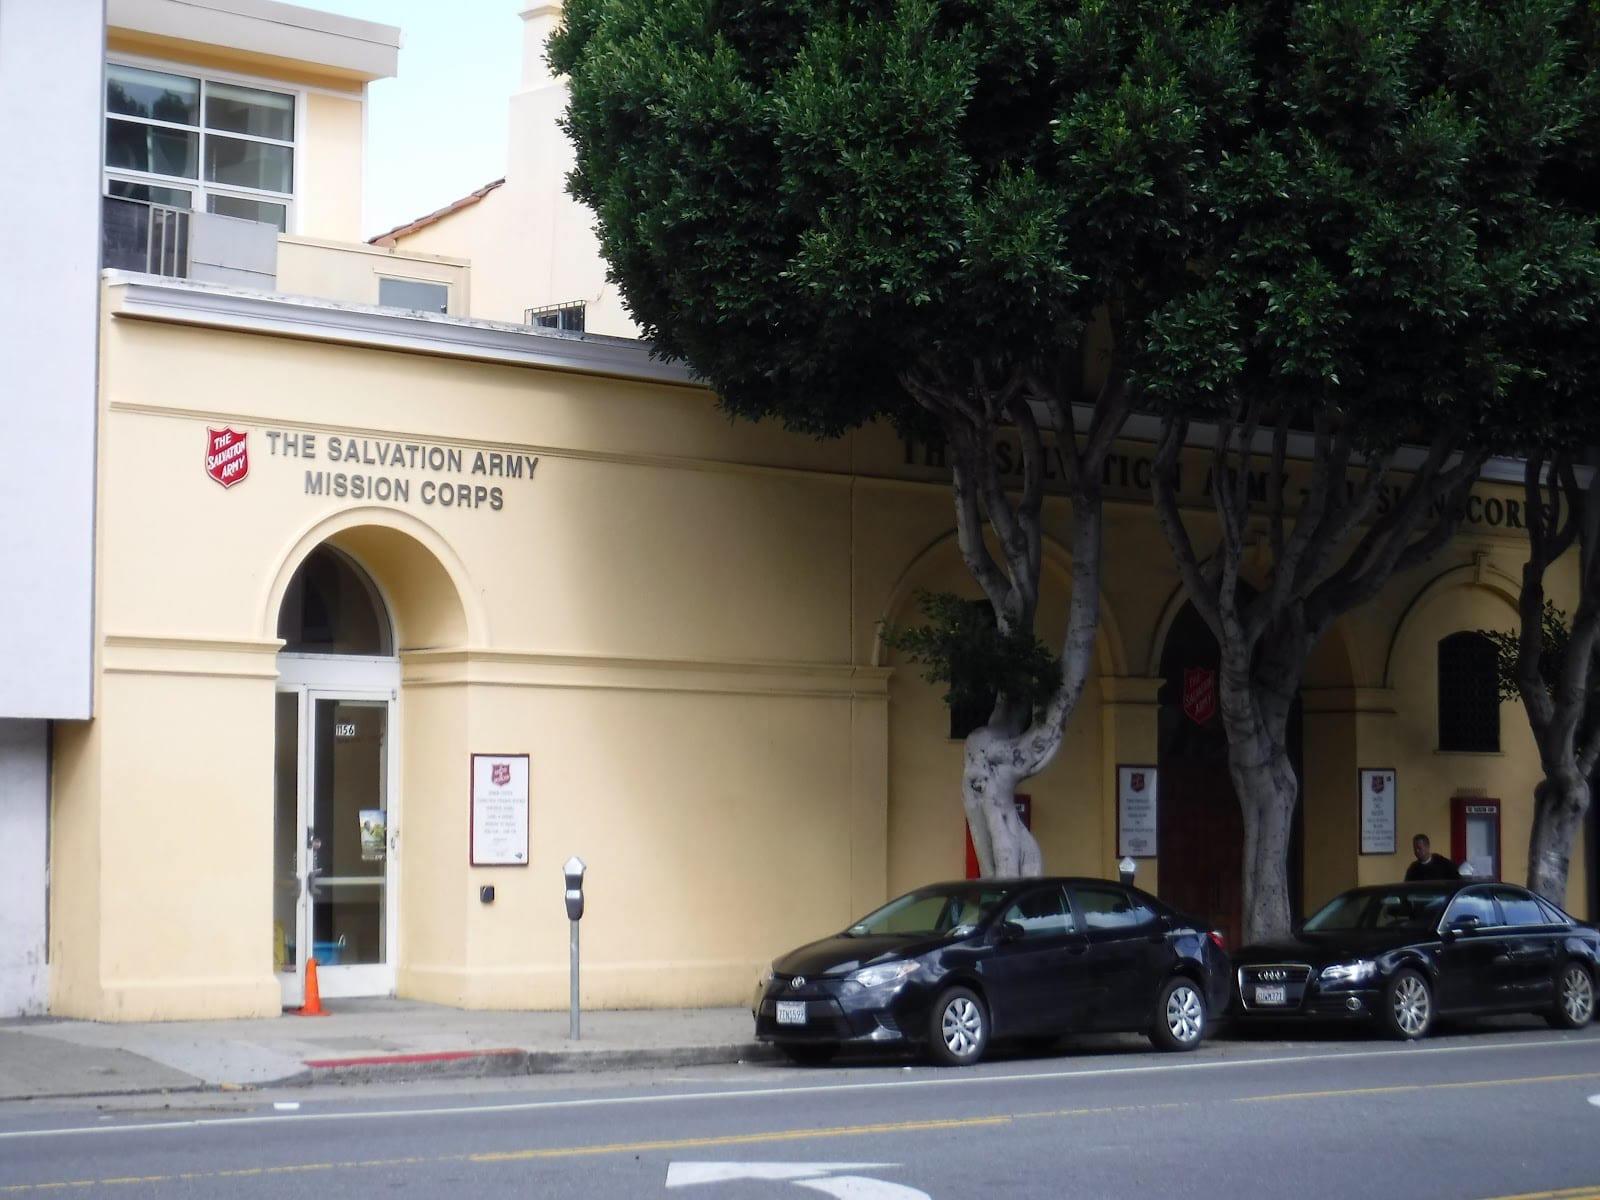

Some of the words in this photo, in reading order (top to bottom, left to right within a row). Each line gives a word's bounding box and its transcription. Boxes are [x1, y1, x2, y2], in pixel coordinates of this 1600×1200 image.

[208, 438, 246, 471] SALVATION
[214, 432, 232, 450] THE
[221, 455, 245, 479] ARMY
[266, 431, 316, 459] THE
[327, 437, 462, 473] SALVATION
[471, 451, 539, 480] ARMY
[304, 470, 409, 503] MISSION
[420, 480, 504, 511] CORPS
[336, 724, 355, 736] 1156
